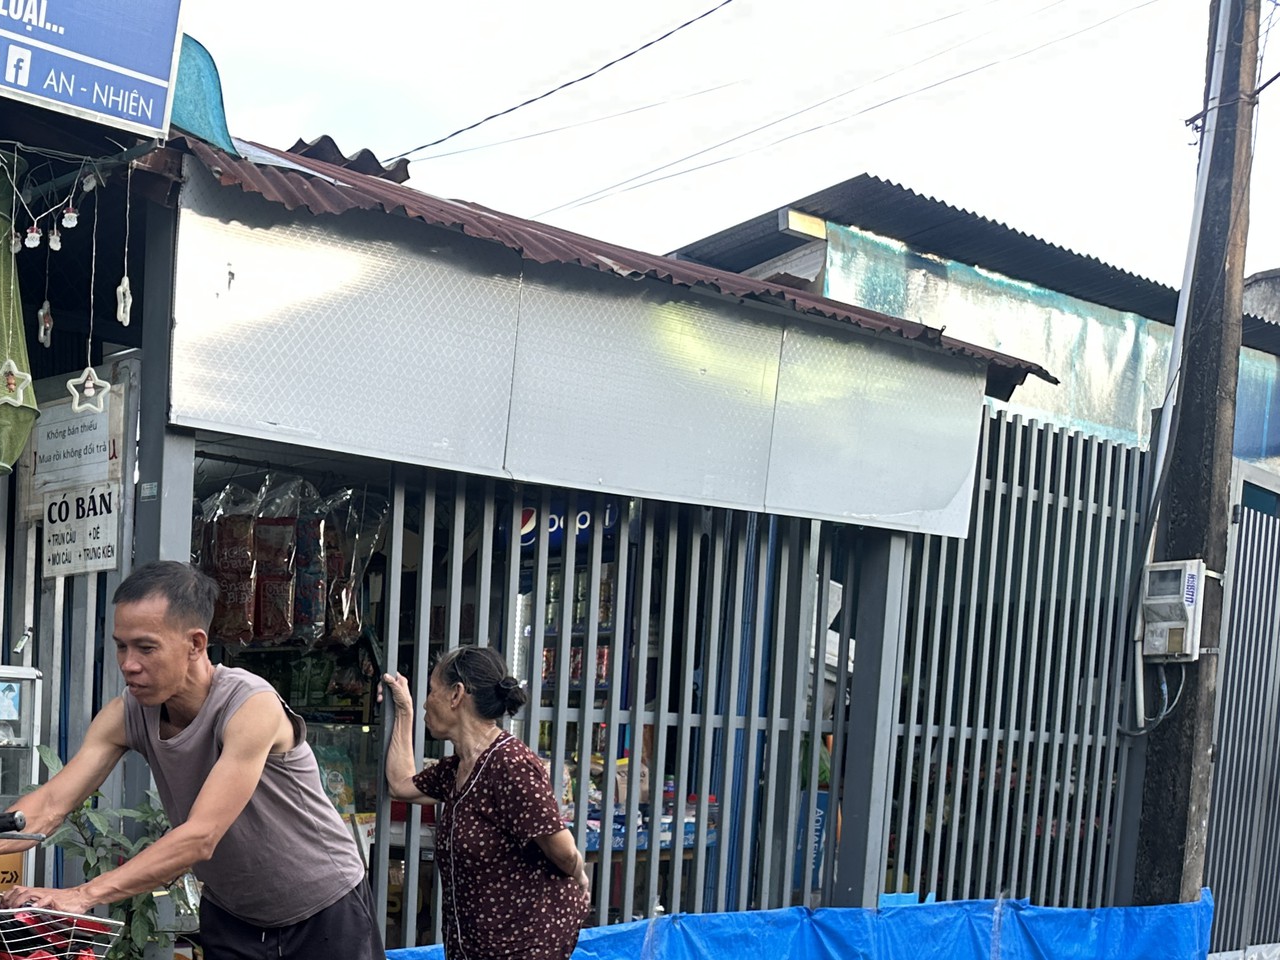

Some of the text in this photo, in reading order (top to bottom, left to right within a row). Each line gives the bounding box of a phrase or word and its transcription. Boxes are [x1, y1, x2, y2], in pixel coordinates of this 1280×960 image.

[43, 68, 75, 97] AN
[92, 82, 153, 120] NHIÊN
[47, 428, 66, 440] Không
[67, 424, 79, 436] bán
[38, 454, 51, 463] Mua
[63, 447, 82, 459] không
[48, 493, 69, 524] CÓ
[75, 487, 112, 519] BÁN
